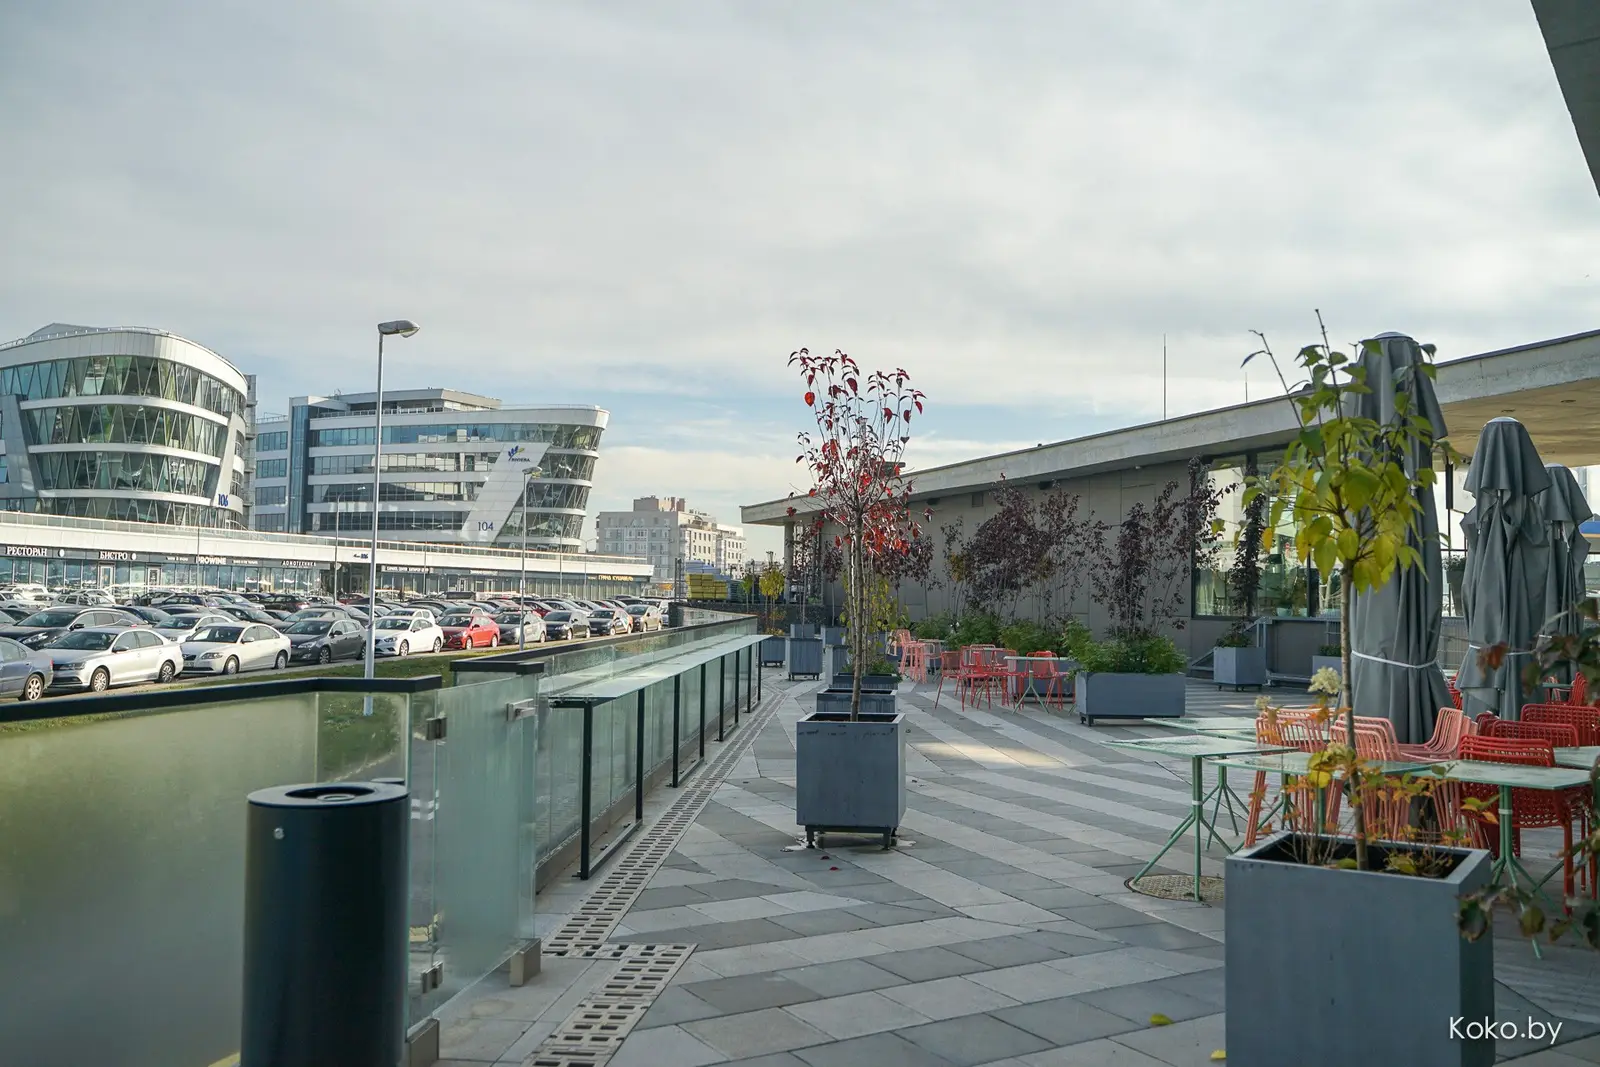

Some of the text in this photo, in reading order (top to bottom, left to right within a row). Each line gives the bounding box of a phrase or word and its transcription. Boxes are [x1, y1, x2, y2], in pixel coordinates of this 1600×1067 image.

[218, 494, 228, 507] 106
[477, 522, 494, 531] 104
[6, 546, 48, 557] РЕСТОРАН
[100, 551, 128, 560] БИСТРО
[195, 555, 227, 565] PROWINE
